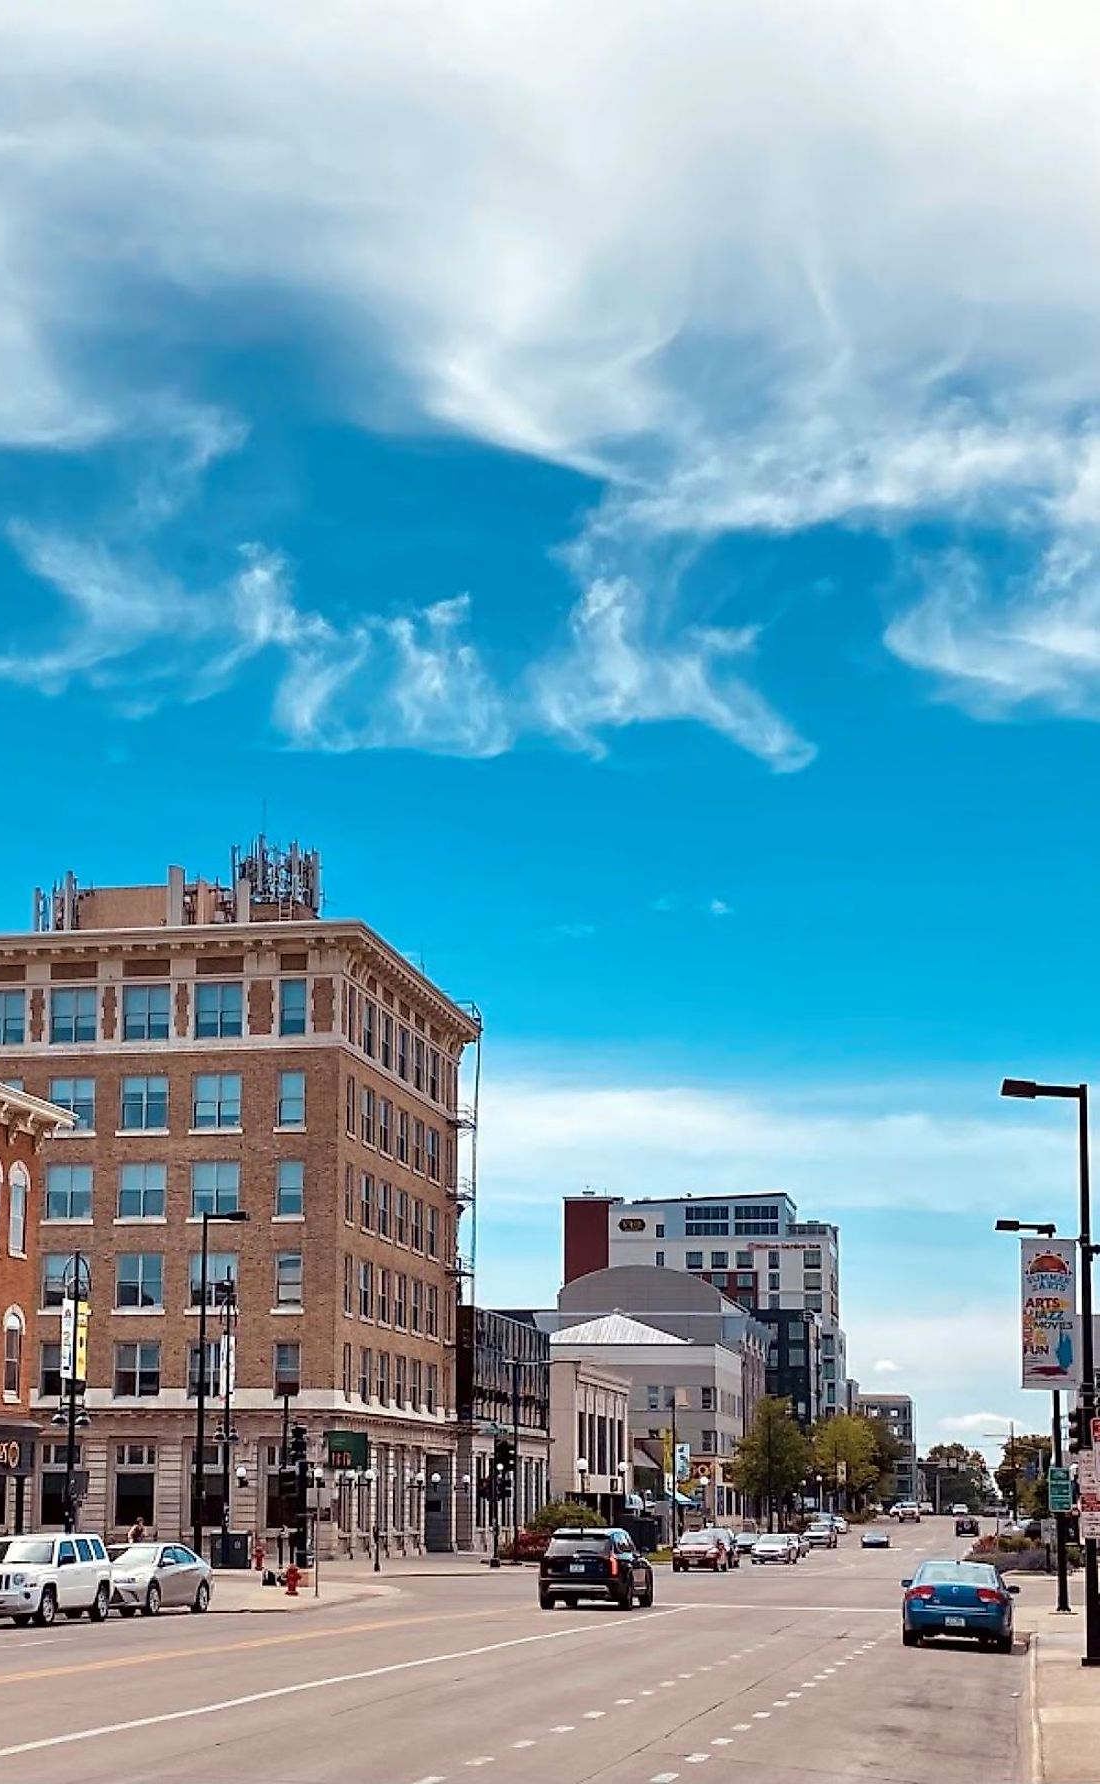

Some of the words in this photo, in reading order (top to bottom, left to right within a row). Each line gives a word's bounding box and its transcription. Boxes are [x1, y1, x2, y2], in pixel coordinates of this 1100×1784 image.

[1025, 1297, 1060, 1308] ARTS
[1035, 1310, 1064, 1320] JAZZ
[1023, 1345, 1049, 1355] FUN
